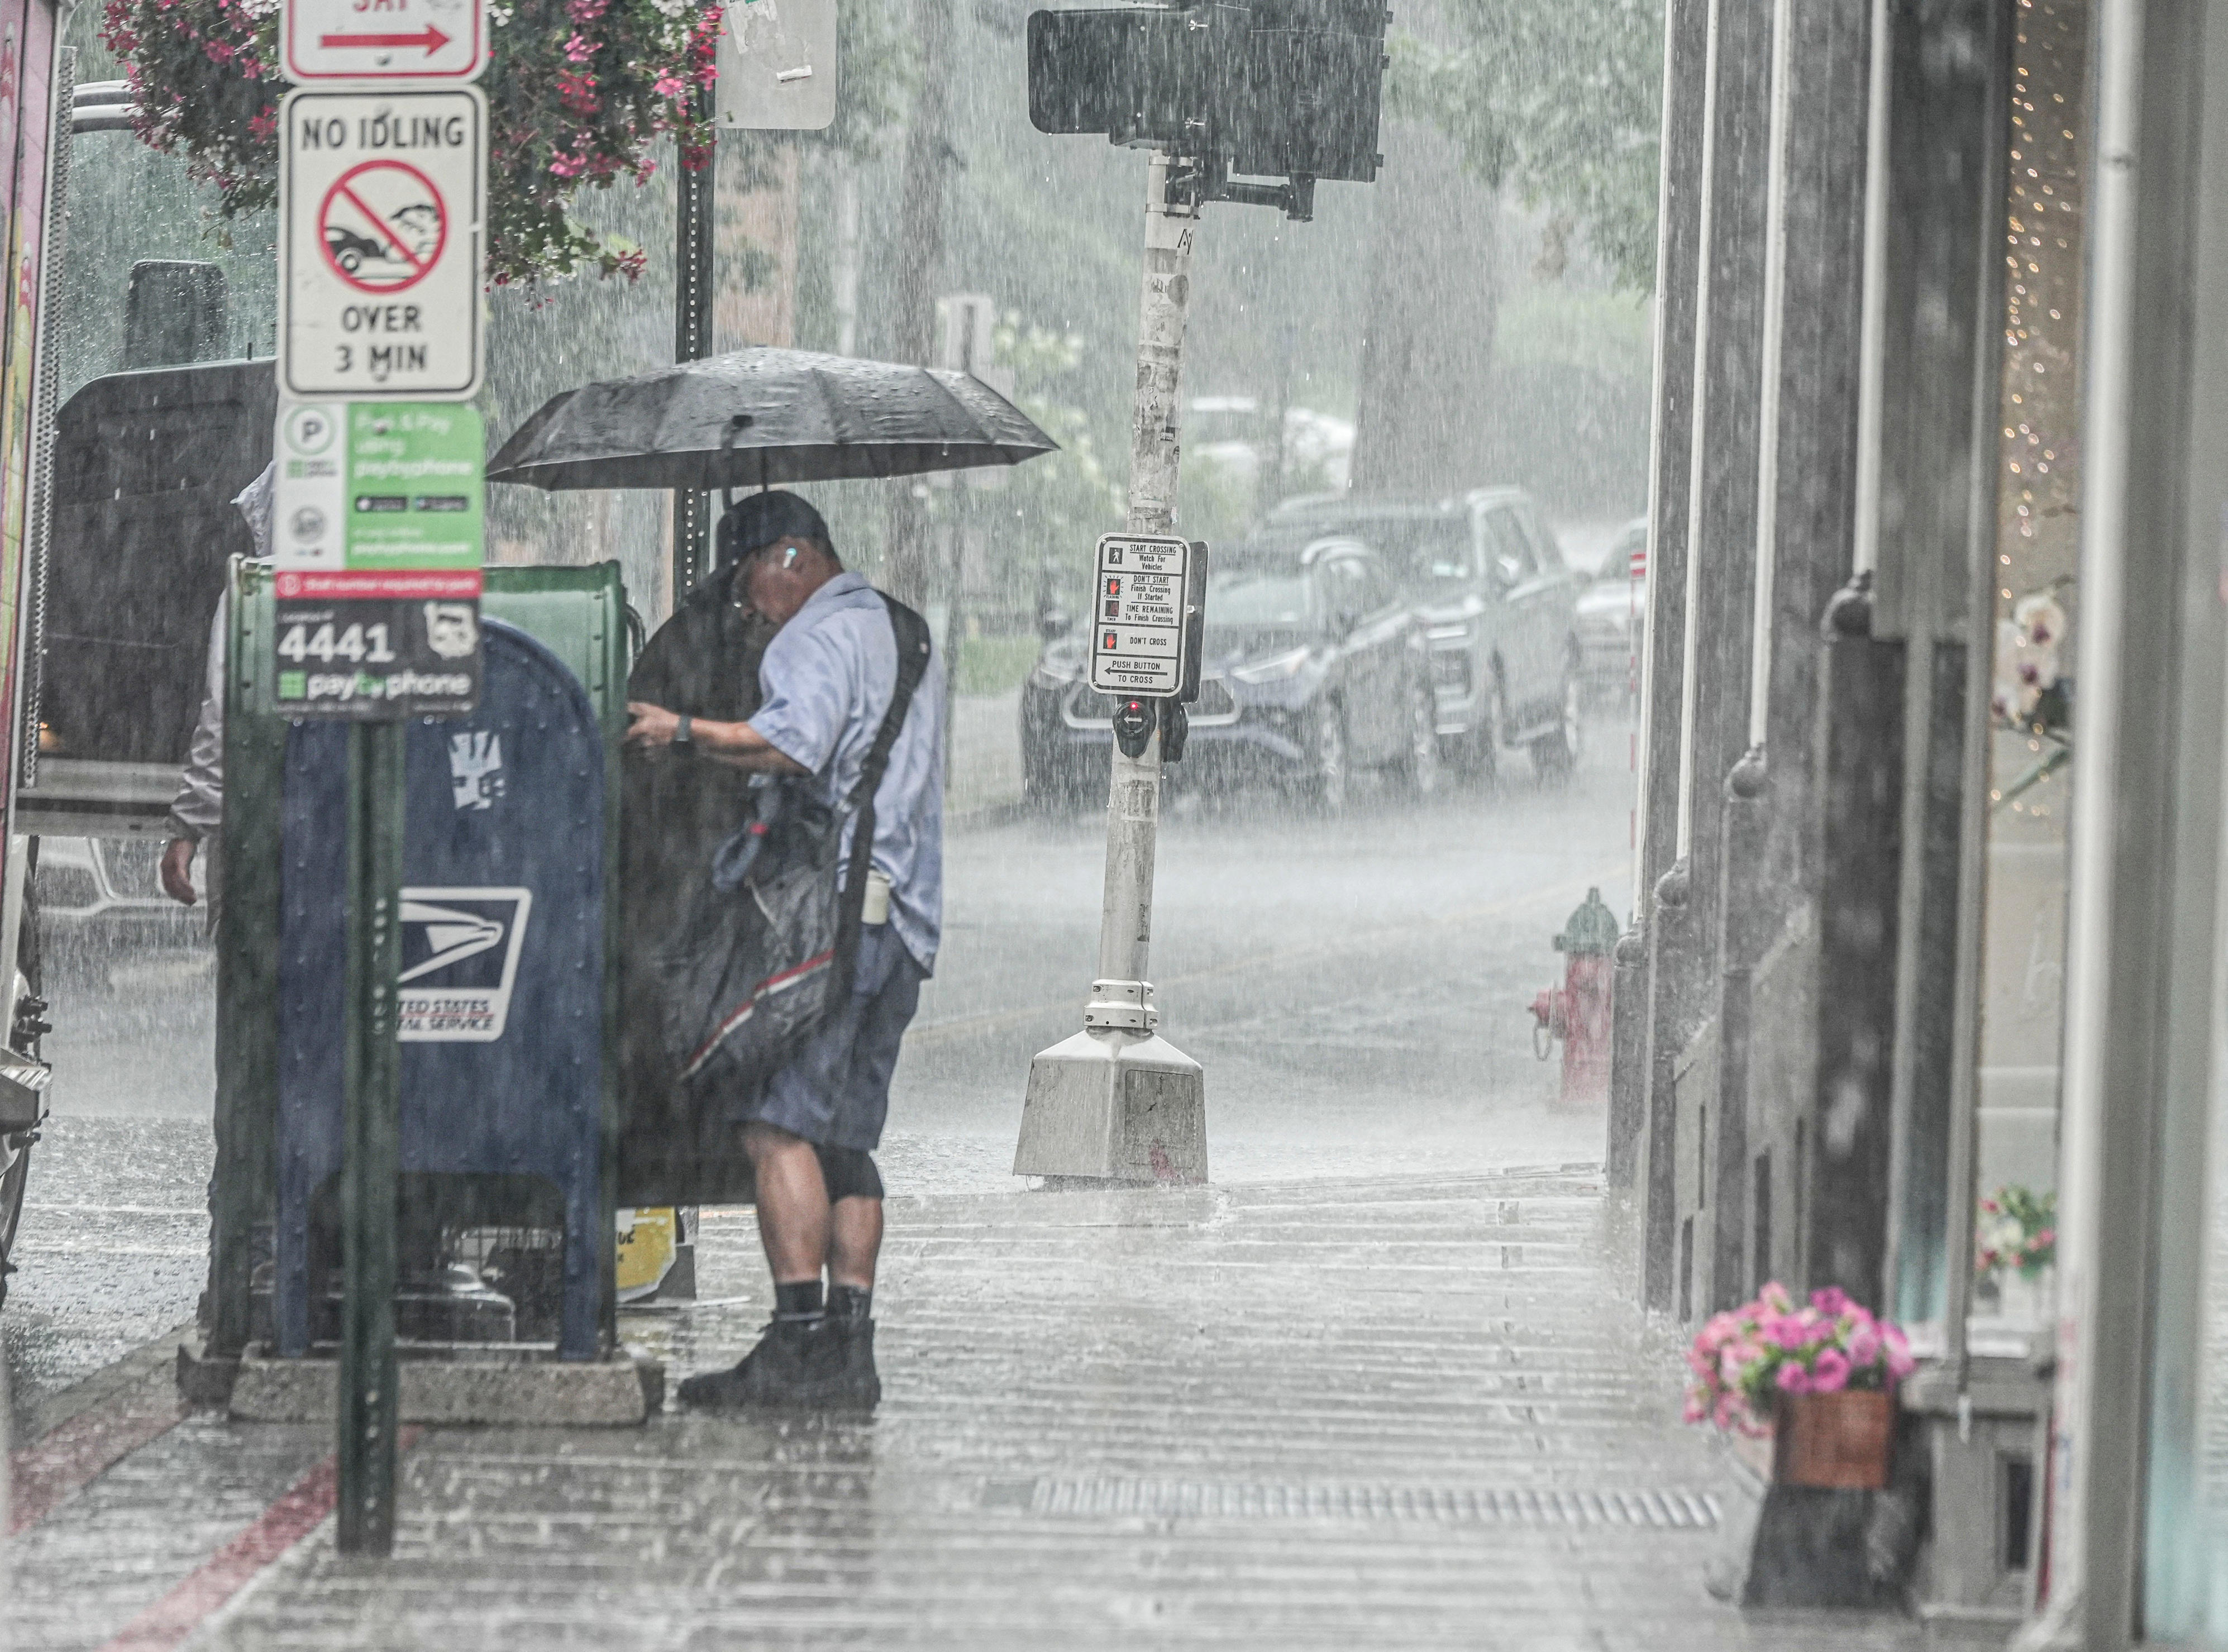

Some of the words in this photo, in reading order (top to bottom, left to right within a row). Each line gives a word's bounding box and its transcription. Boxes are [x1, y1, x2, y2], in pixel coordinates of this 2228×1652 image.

[302, 118, 346, 150] NO
[359, 117, 464, 148] IDLING
[342, 305, 421, 332] OVER
[336, 346, 351, 373] 3
[370, 345, 427, 372] MIN
[302, 420, 322, 443] P
[1149, 585, 1171, 595] Crossing
[1142, 605, 1173, 614] REMAINING
[1152, 614, 1173, 624] Crossing
[279, 623, 395, 663] 4441
[1134, 662, 1160, 670] BUTTON
[308, 670, 471, 700] paybyphone
[397, 1000, 430, 1014] TED
[432, 999, 489, 1014] STATES
